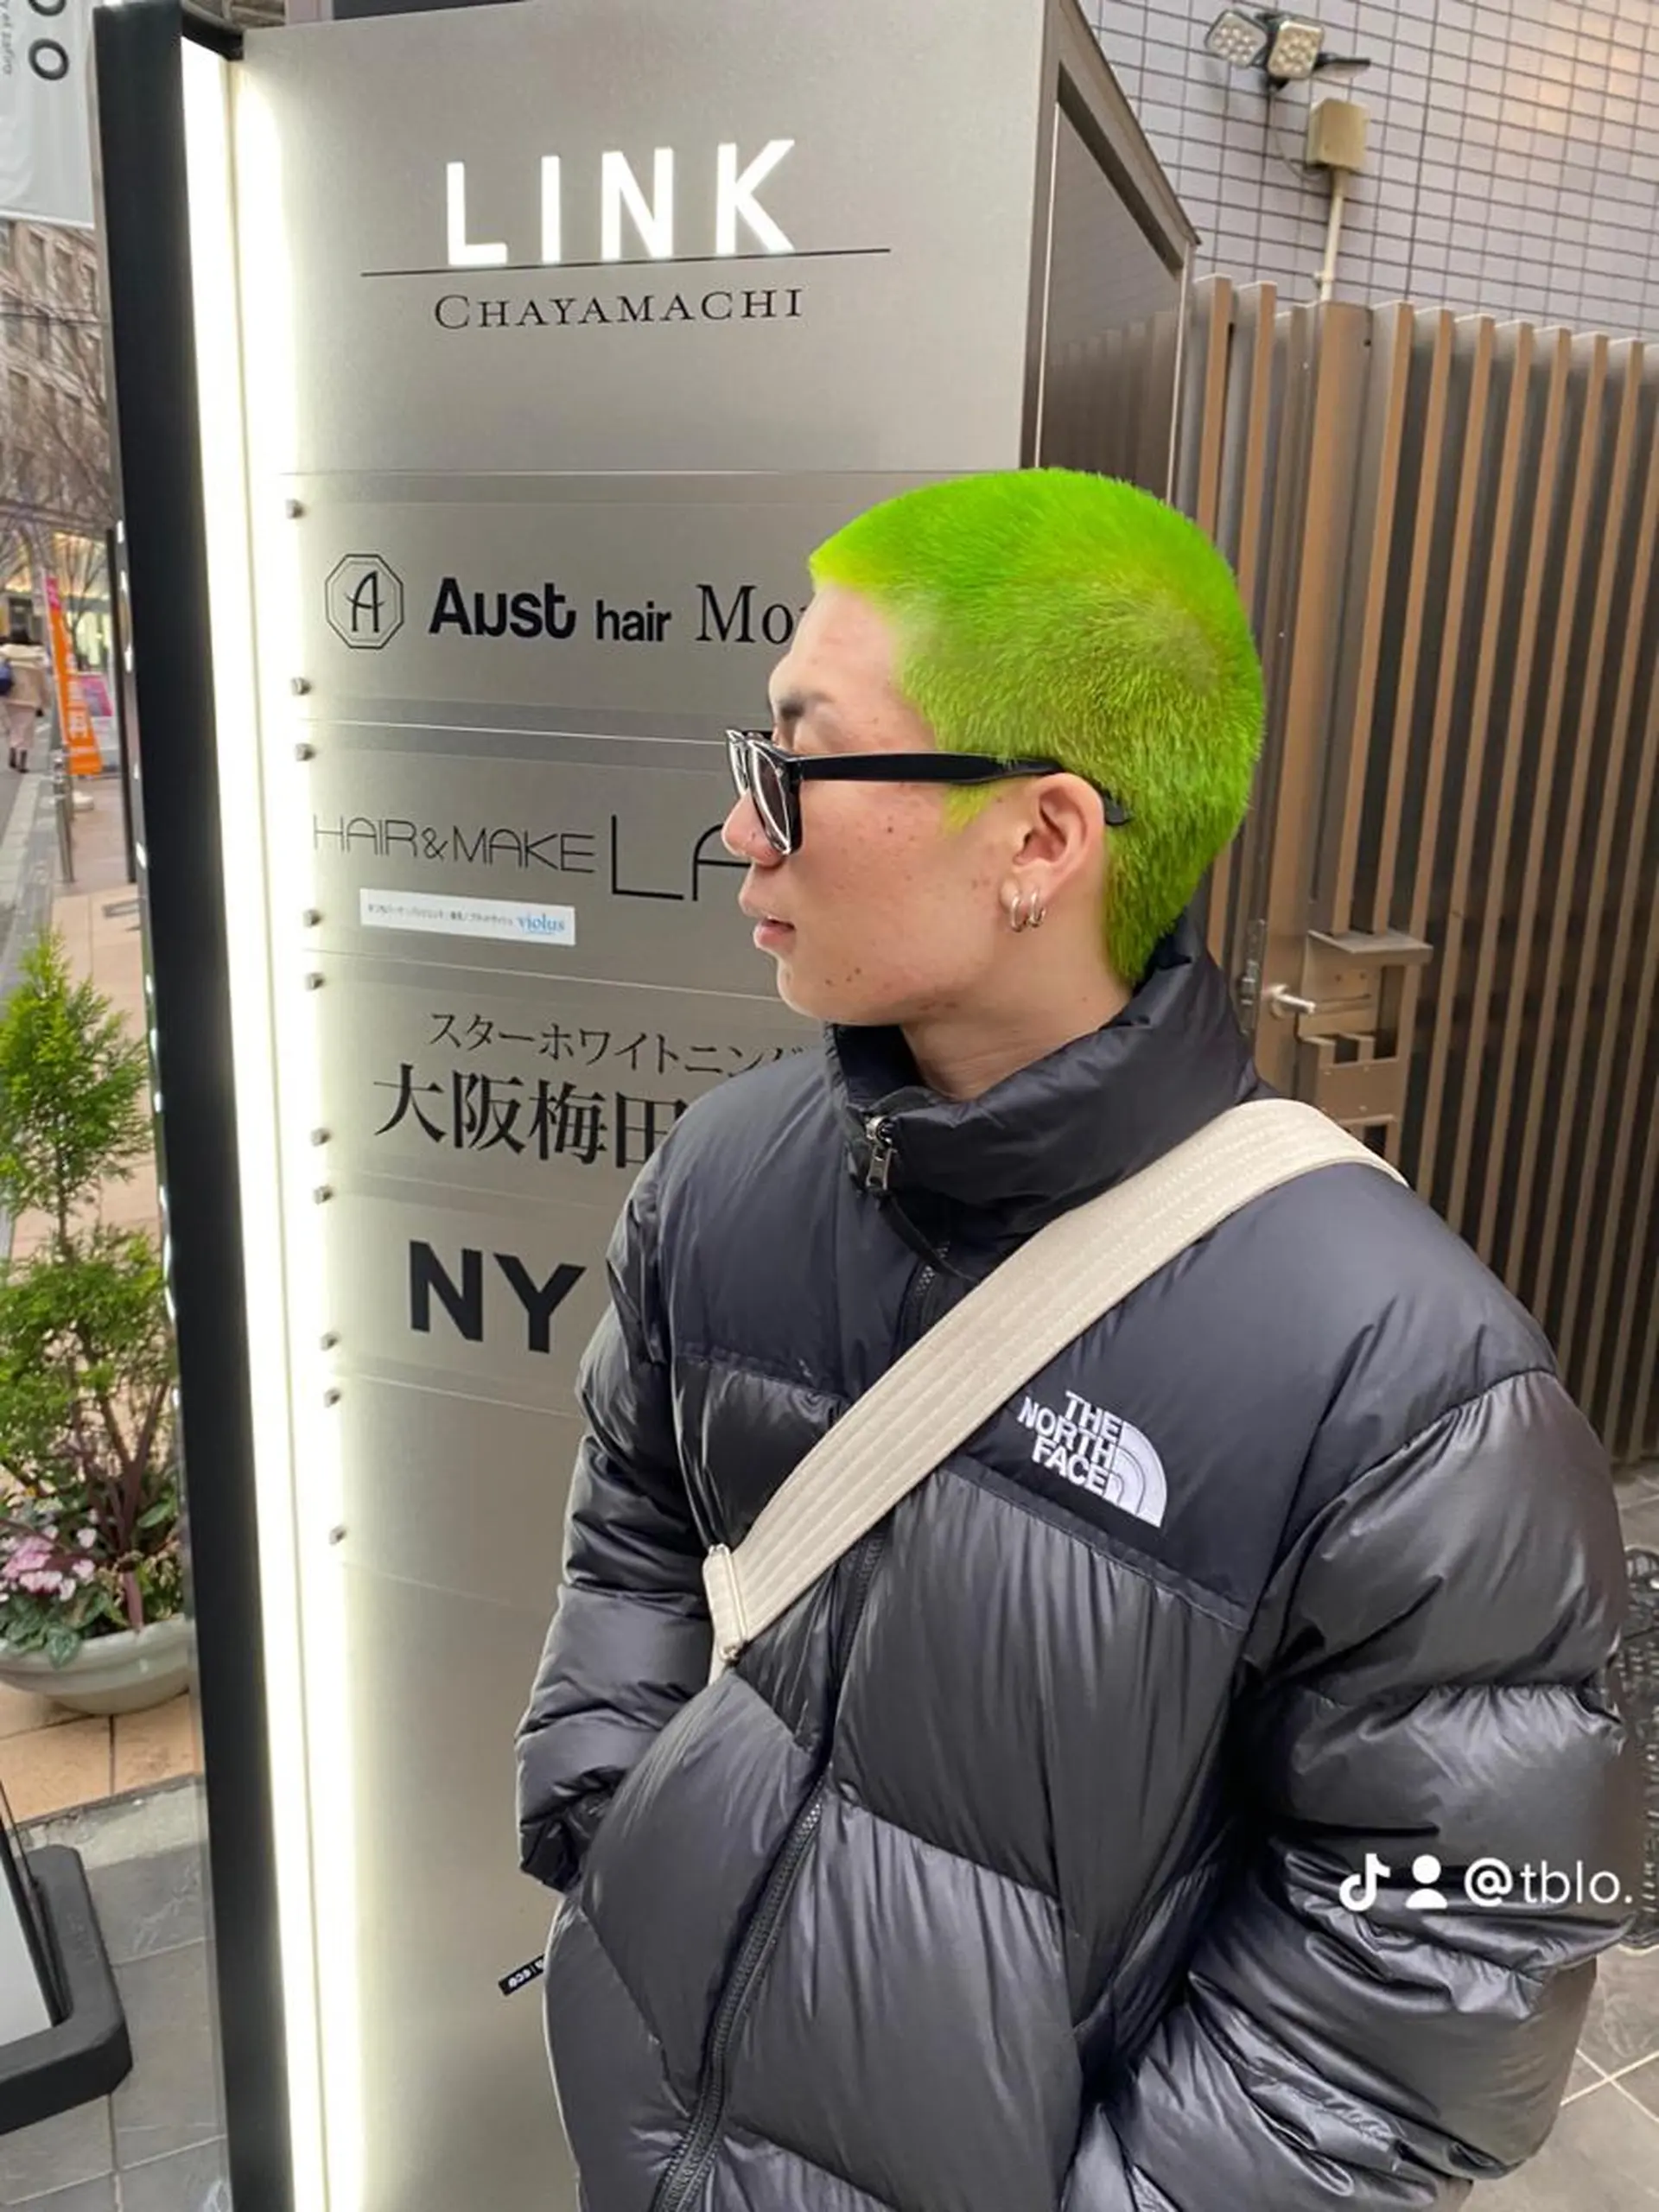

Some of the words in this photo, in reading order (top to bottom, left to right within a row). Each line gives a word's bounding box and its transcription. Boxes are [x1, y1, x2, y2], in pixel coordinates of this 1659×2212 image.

[446, 138, 797, 266] LINK
[434, 288, 804, 331] CHAYAMACHI
[429, 576, 576, 639] Aust
[596, 599, 672, 641] hair
[696, 584, 807, 645] Mo
[313, 814, 596, 874] HAIR&MAKE
[517, 912, 565, 934] violus
[410, 1239, 587, 1354] NY
[1017, 1396, 1116, 1469] NORTH
[1065, 1389, 1122, 1442] THE
[1032, 1435, 1111, 1493] FACE
